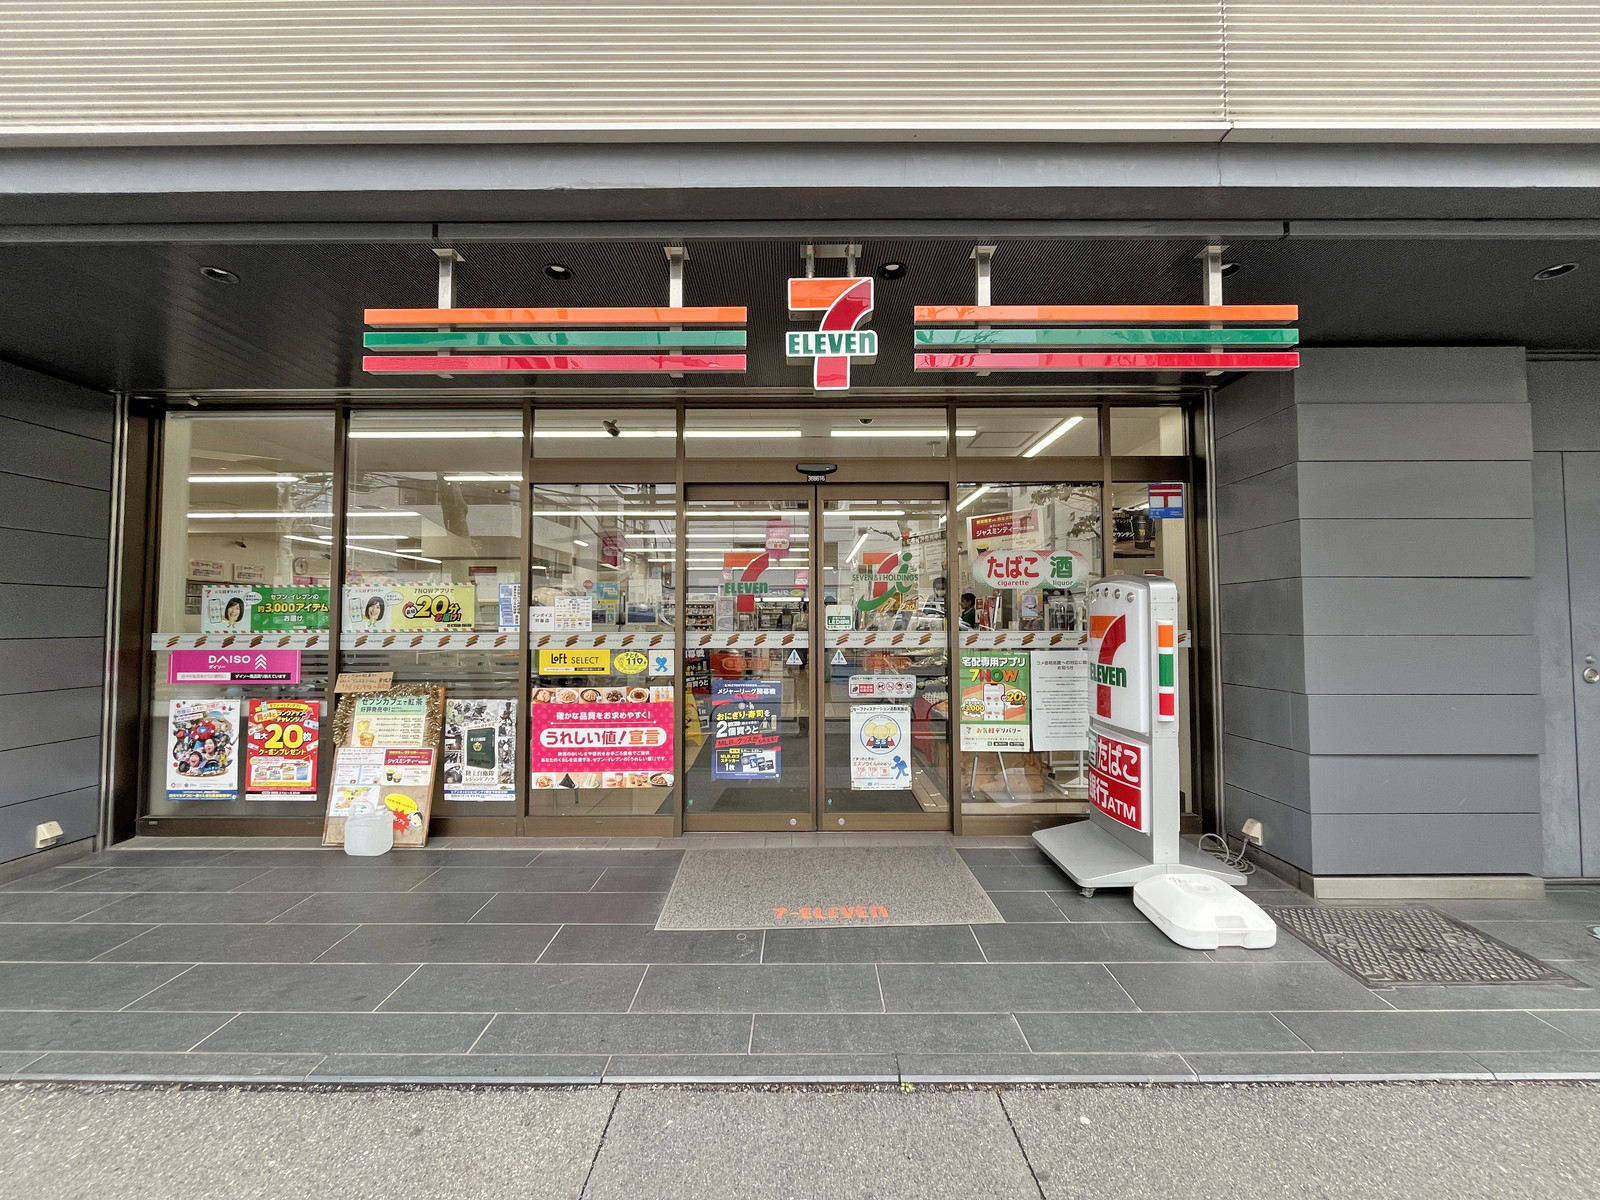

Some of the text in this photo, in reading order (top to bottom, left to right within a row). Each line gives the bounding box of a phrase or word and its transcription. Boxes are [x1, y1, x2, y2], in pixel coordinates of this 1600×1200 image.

[987, 555, 1073, 579] たばこ 酒
[883, 573, 918, 581] HOLDINGS
[997, 580, 1073, 588] cigarette liquor
[208, 655, 251, 664] DAISO
[571, 656, 600, 665] SELECT
[962, 657, 1026, 667] 宅配専用アプリ
[969, 668, 1019, 682] 7NOW
[556, 711, 651, 720] 確かな品質をお求めやすく!
[545, 730, 660, 745] うれしい値!宣言
[1097, 738, 1139, 783] たばこ
